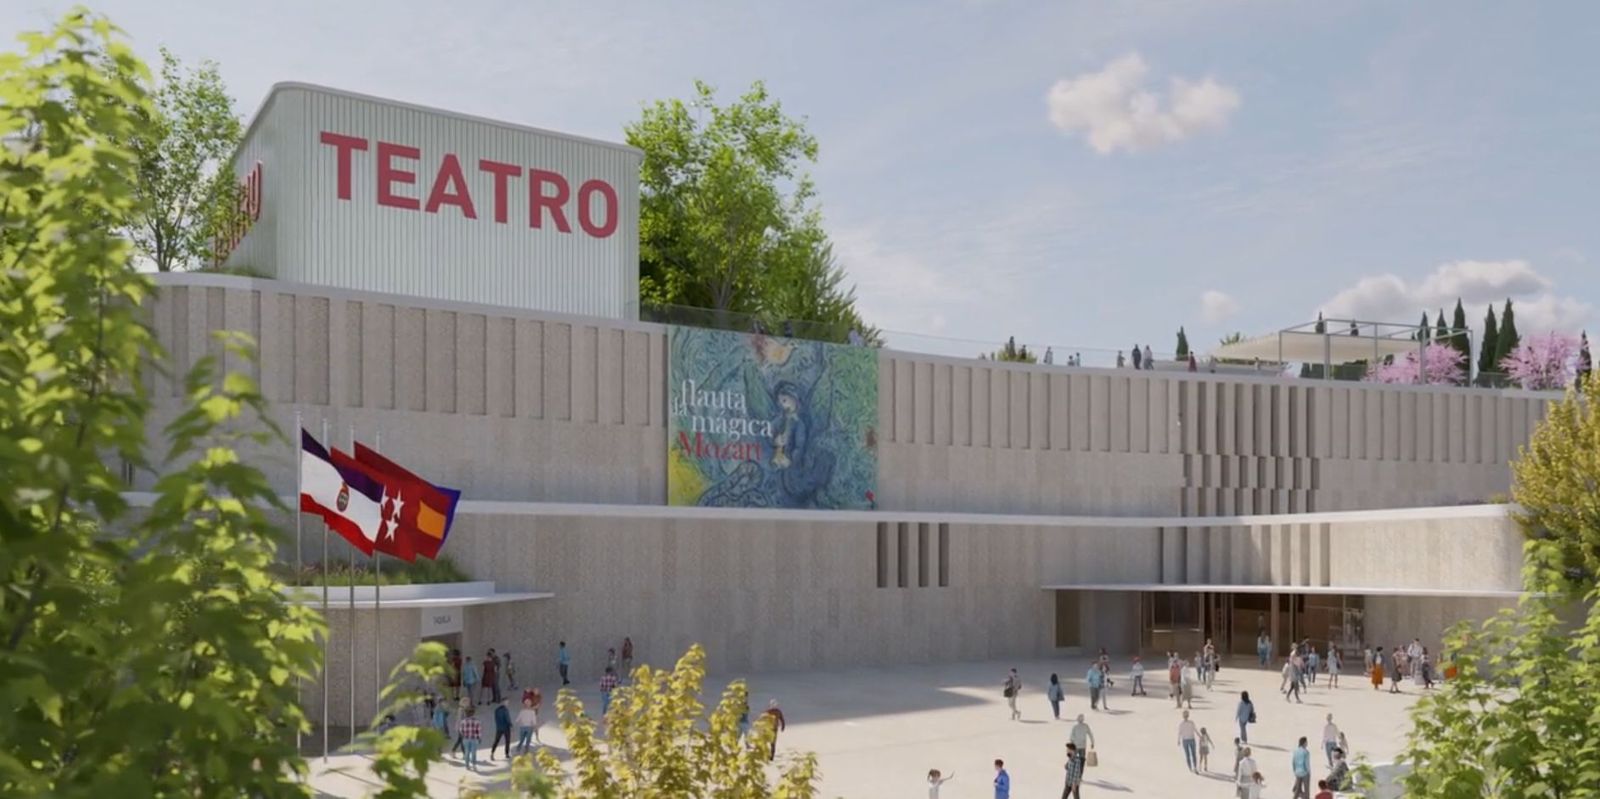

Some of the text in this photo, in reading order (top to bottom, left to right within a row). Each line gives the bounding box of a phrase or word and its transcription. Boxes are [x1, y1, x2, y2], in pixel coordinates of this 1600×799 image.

[320, 131, 618, 238] TEATRO
[682, 379, 747, 414] flauta
[692, 410, 773, 441] mágica
[678, 432, 762, 462] Mozart
